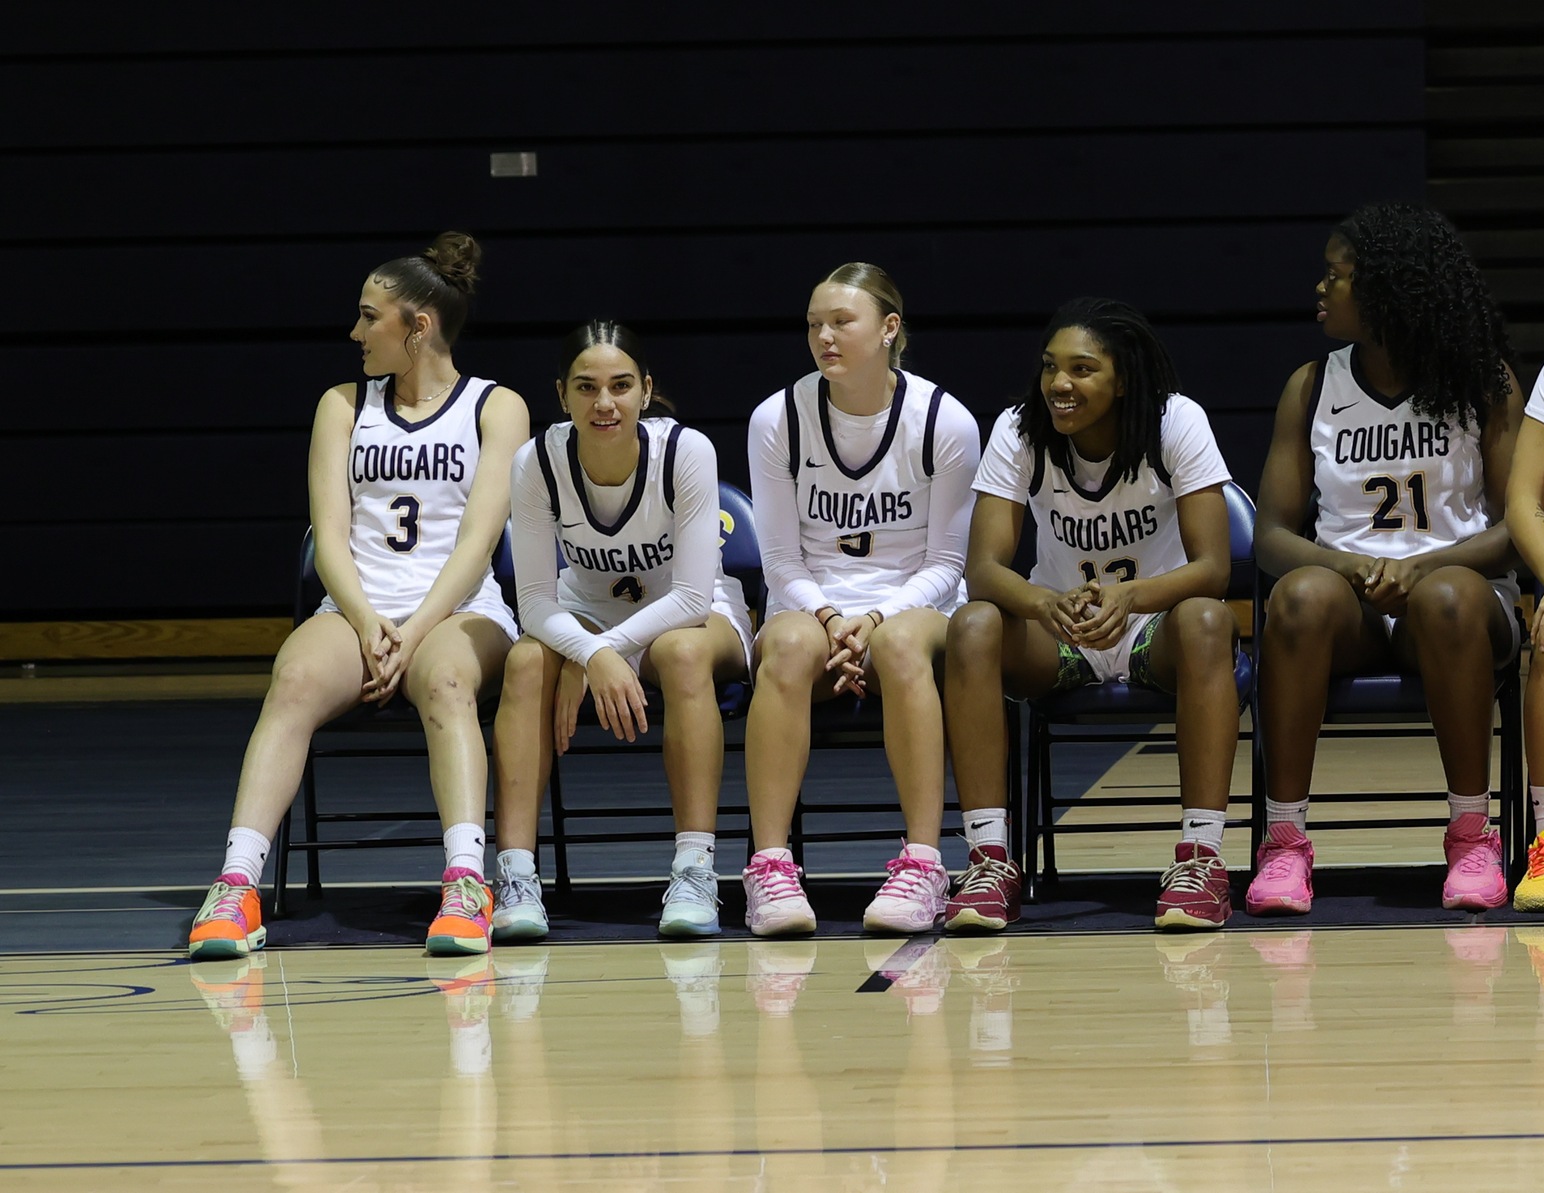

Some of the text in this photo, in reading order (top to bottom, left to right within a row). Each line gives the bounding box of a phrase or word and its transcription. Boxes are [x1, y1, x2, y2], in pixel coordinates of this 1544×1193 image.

[353, 443, 465, 484] COUGARS
[1335, 422, 1449, 464] COUGARS
[385, 493, 422, 554] 3
[808, 483, 912, 529] COUGARS
[1362, 471, 1430, 532] 21
[1050, 505, 1158, 551] COUGARS
[563, 533, 674, 573] COUGARS
[609, 576, 647, 605] 4
